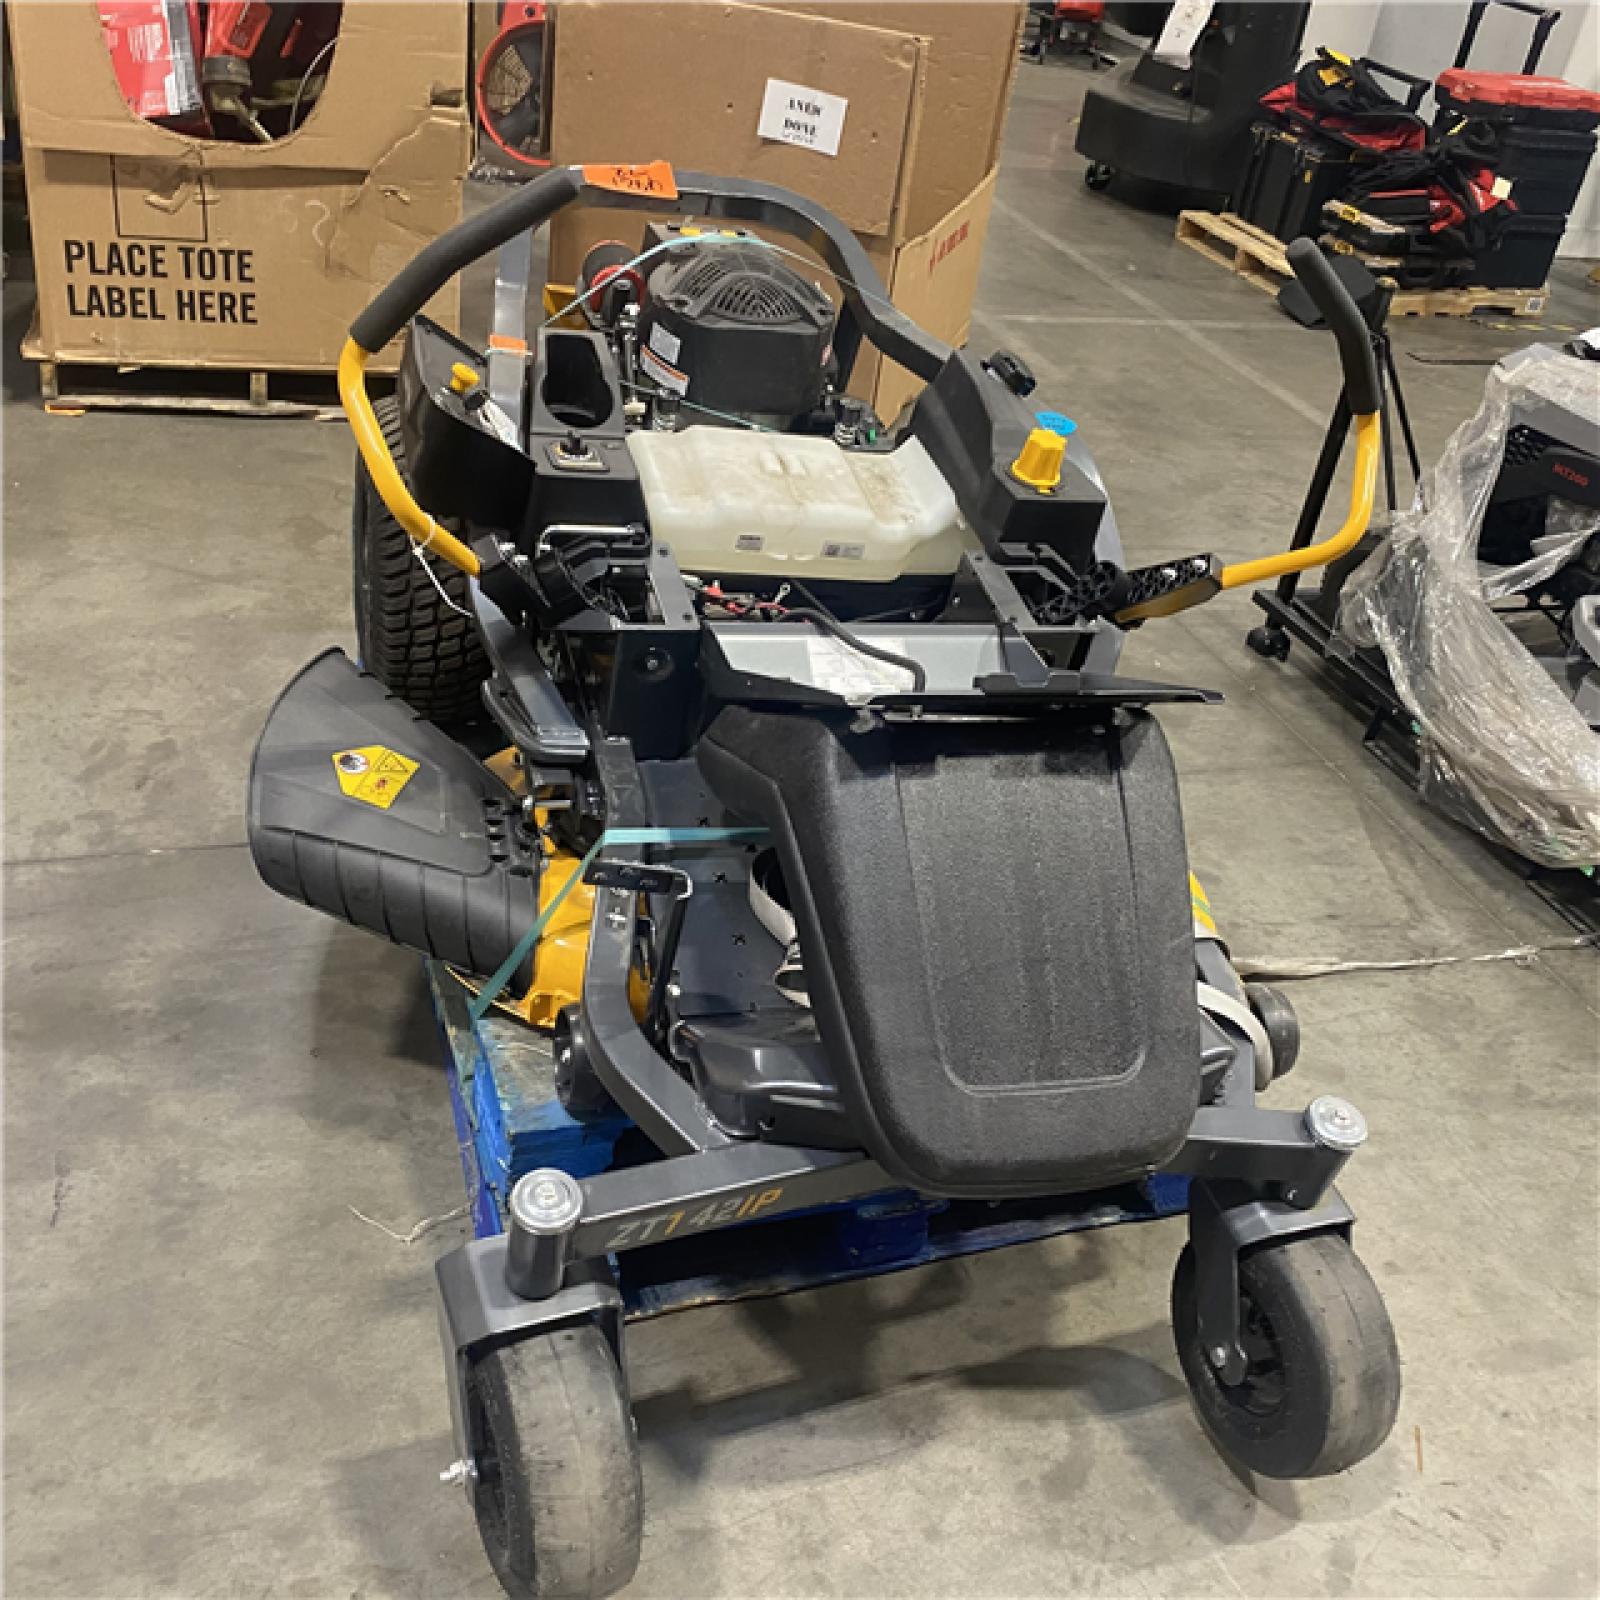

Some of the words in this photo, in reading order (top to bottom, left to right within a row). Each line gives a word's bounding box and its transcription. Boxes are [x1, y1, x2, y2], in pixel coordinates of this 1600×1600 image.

[64, 240, 169, 278] PLACE
[177, 247, 255, 283] TOTE
[67, 284, 166, 321] LABEL
[176, 290, 258, 325] HERE
[605, 1209, 686, 1248] ZT1
